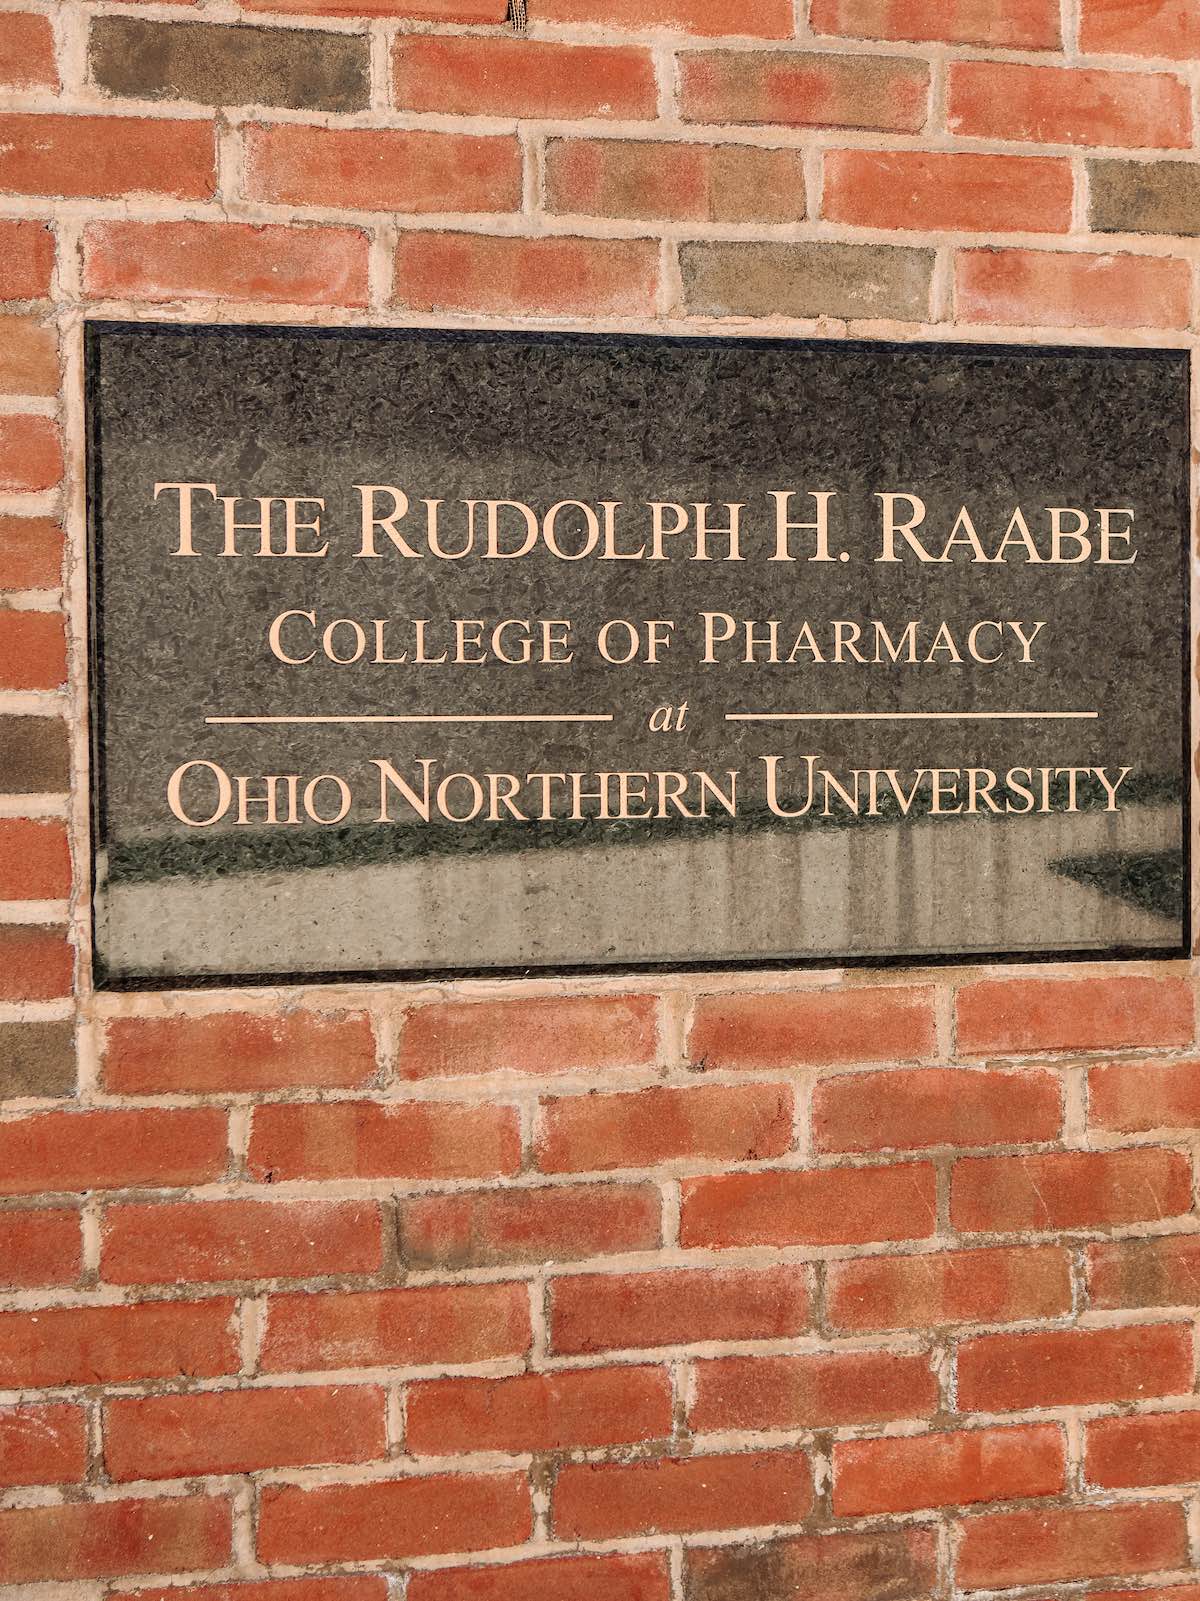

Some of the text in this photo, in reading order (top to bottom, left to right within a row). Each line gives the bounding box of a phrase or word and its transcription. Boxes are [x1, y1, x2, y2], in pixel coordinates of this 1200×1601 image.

[153, 482, 1138, 564] THE RUDOLPH H. RAABE
[268, 609, 1047, 665] COLLEGE OF PHARMACY
[648, 700, 690, 732] at
[167, 755, 1133, 827] OHIO NORTHERN UNIVERSITY
